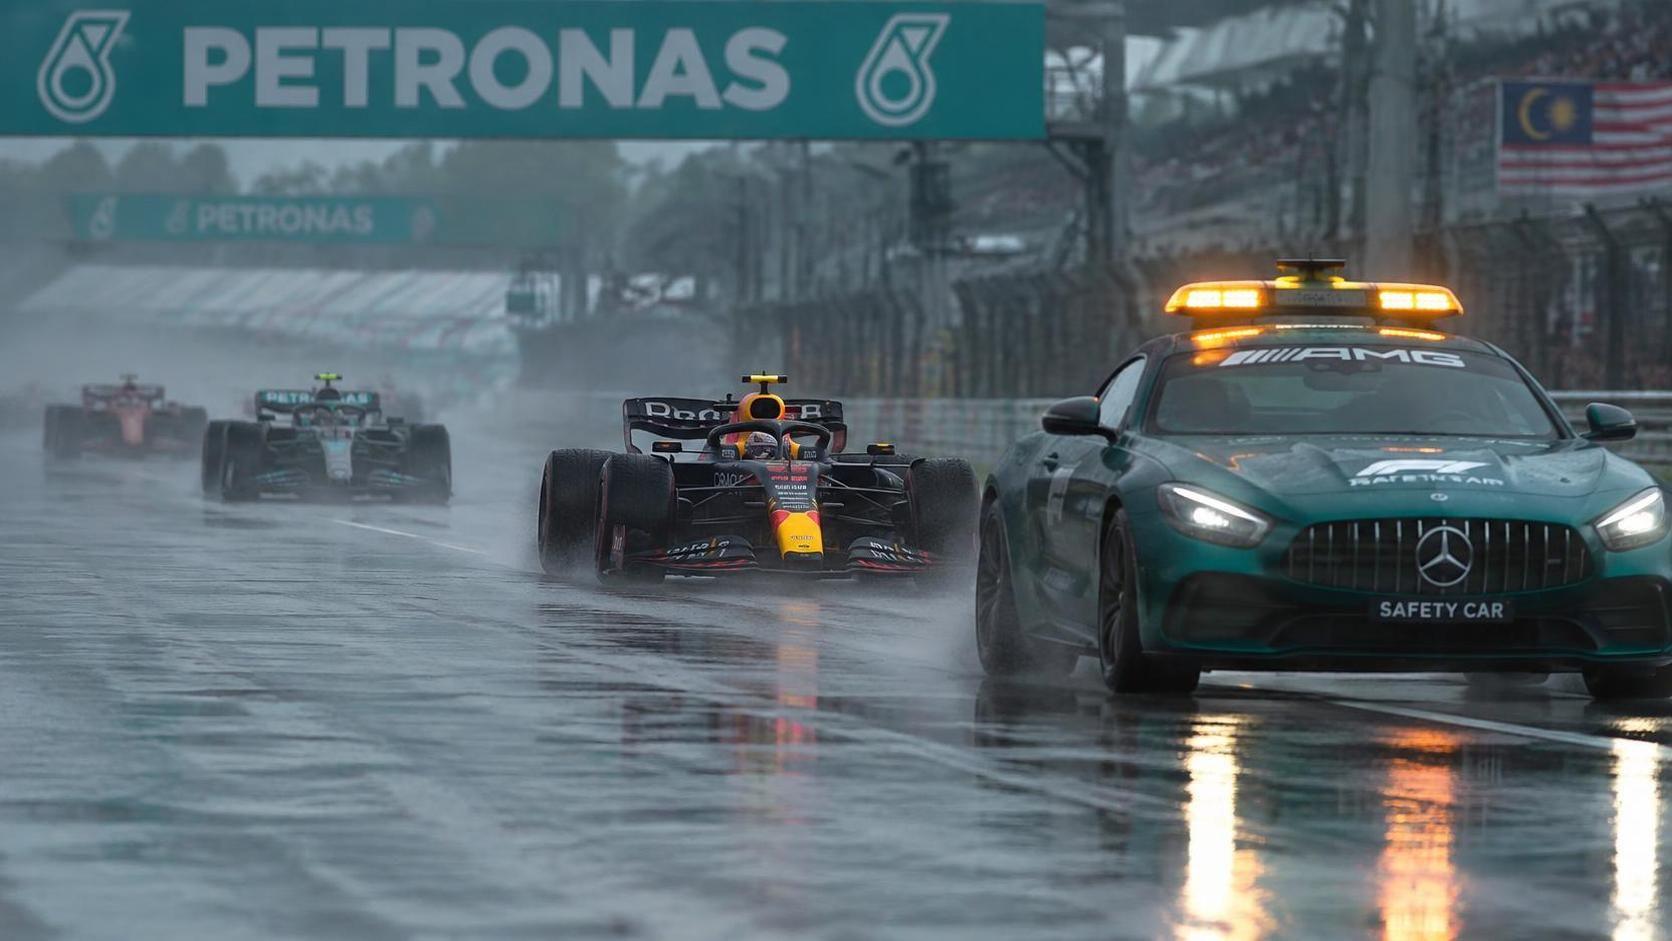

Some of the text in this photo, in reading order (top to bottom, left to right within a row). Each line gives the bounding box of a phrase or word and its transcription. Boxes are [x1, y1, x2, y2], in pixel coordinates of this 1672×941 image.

[183, 27, 789, 110] PETRONAS
[198, 205, 374, 234] PETRONAS
[1292, 347, 1466, 367] AMG
[1380, 601, 1504, 618] SAFETY CAR
